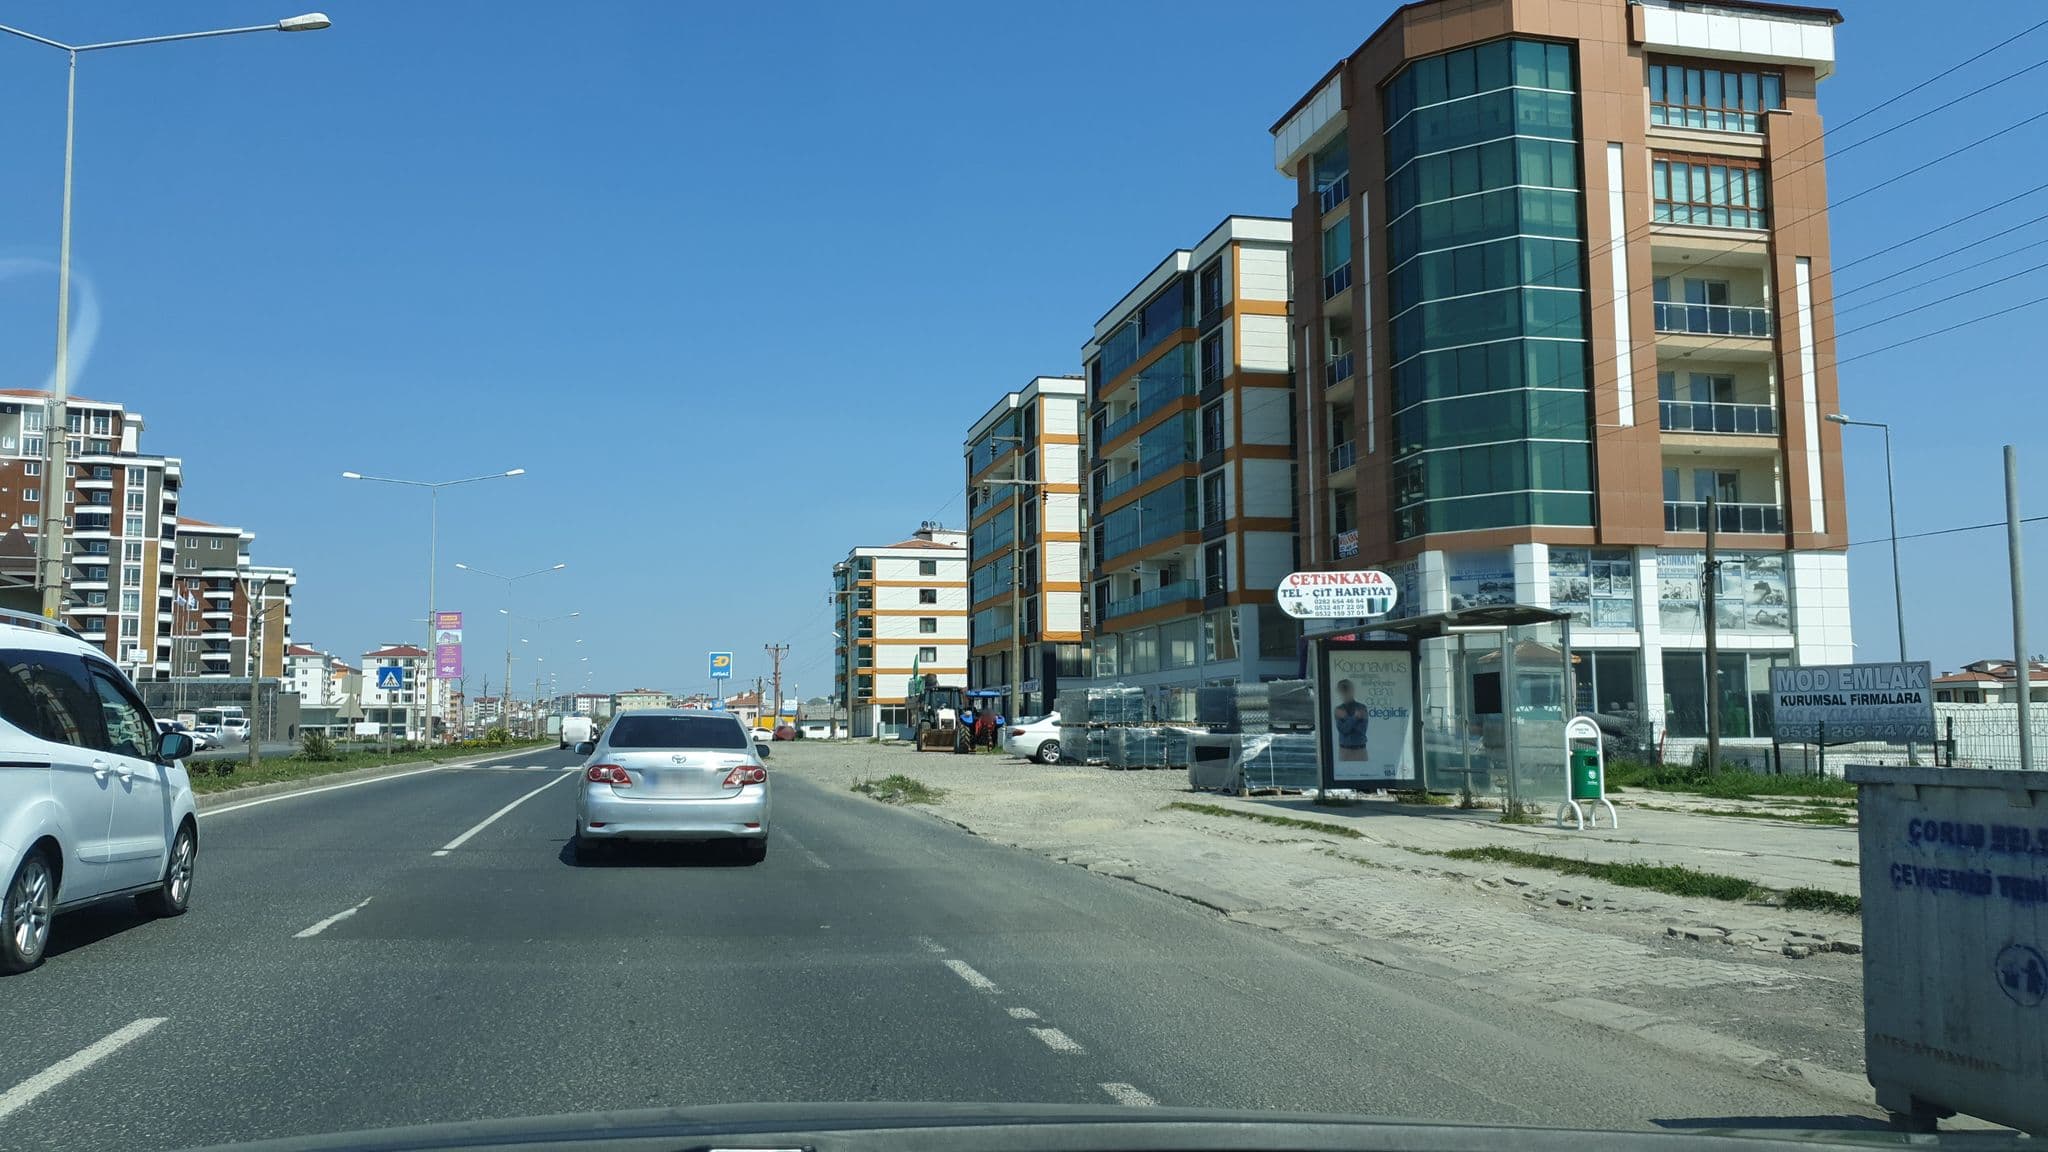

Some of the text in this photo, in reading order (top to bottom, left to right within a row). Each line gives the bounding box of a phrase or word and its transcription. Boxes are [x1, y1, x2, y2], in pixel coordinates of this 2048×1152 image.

[1281, 589, 1302, 598] TEL
[1776, 664, 1926, 692] MOD EMLAK
[1780, 694, 1847, 707] KURUMSAL
[1831, 725, 1866, 738] 266
[1872, 724, 1897, 738] 74
[1903, 724, 1930, 738] 74
